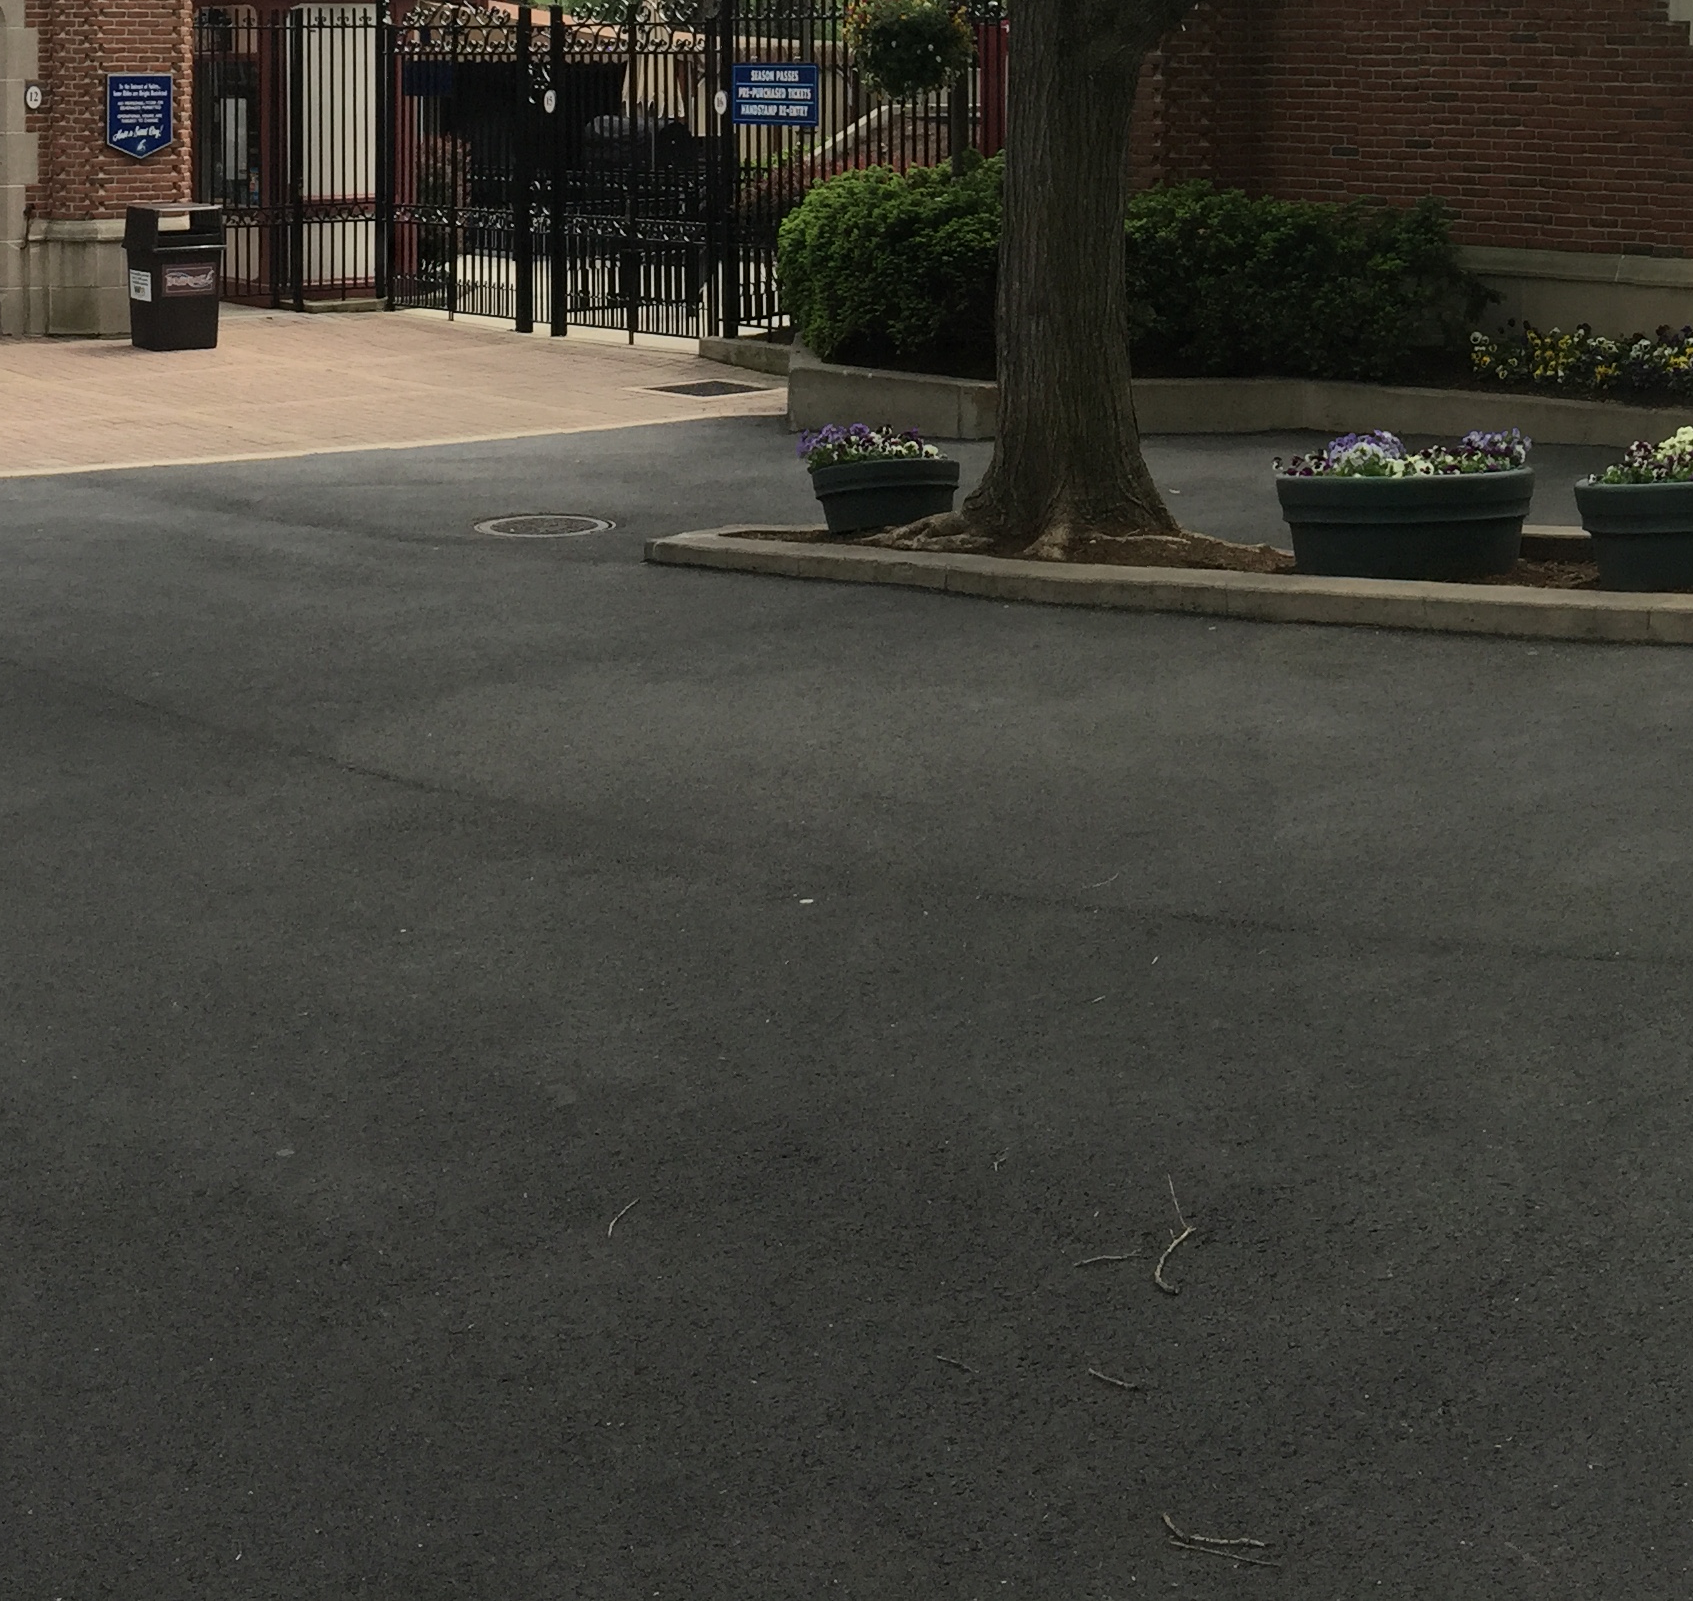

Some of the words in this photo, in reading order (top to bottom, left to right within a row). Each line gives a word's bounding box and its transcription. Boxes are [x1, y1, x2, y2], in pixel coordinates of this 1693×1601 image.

[751, 70, 775, 82] SEASON
[775, 70, 799, 82] PASSES
[29, 91, 39, 102] 12
[787, 88, 812, 100] TICKETS
